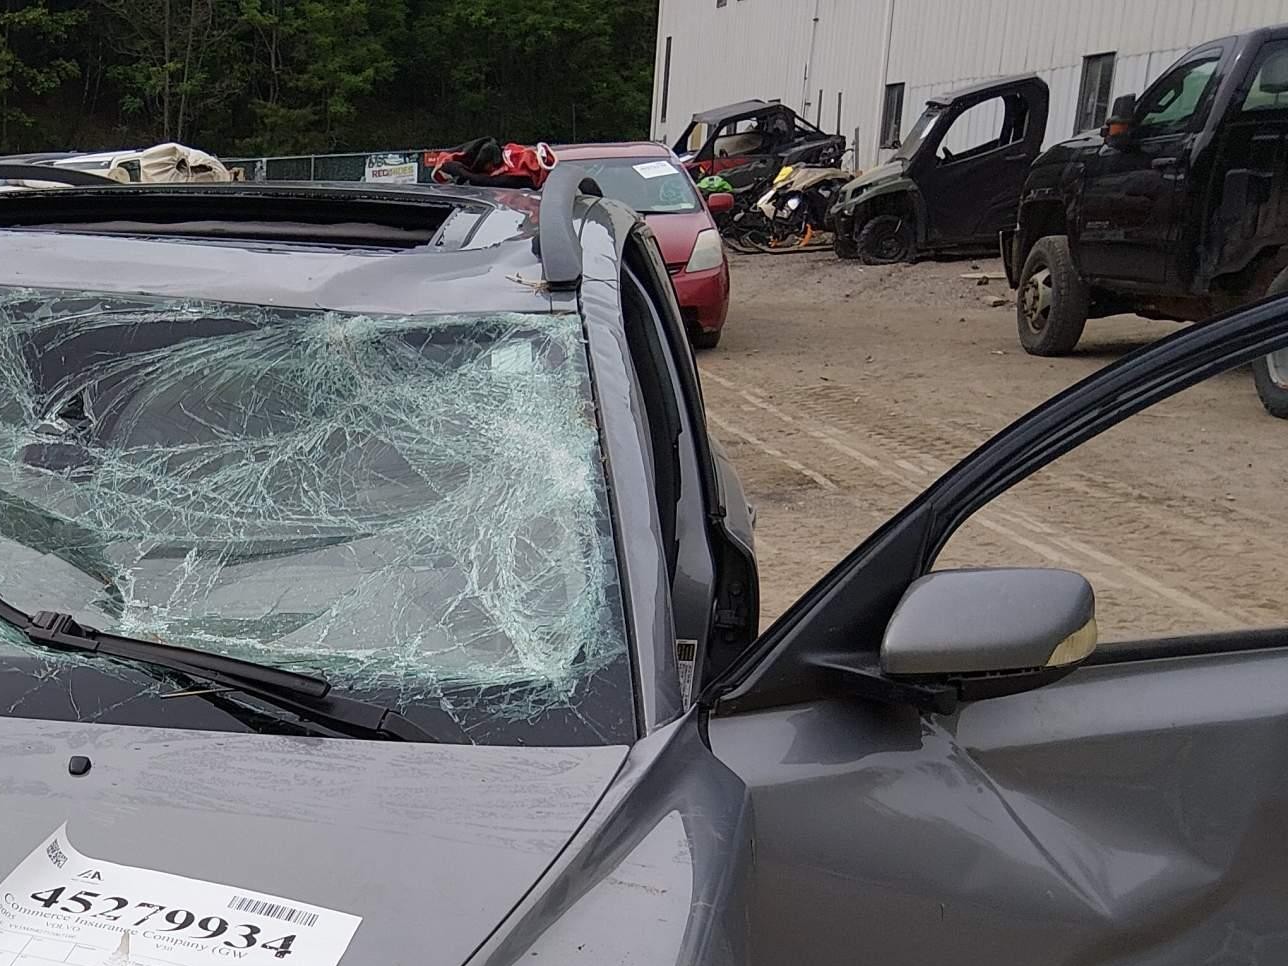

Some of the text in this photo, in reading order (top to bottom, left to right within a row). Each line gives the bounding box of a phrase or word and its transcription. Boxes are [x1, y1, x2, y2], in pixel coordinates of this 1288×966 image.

[4, 892, 72, 921] Commerce
[142, 930, 209, 952] Company
[211, 943, 249, 959] (GW
[30, 886, 297, 959] 45279934
